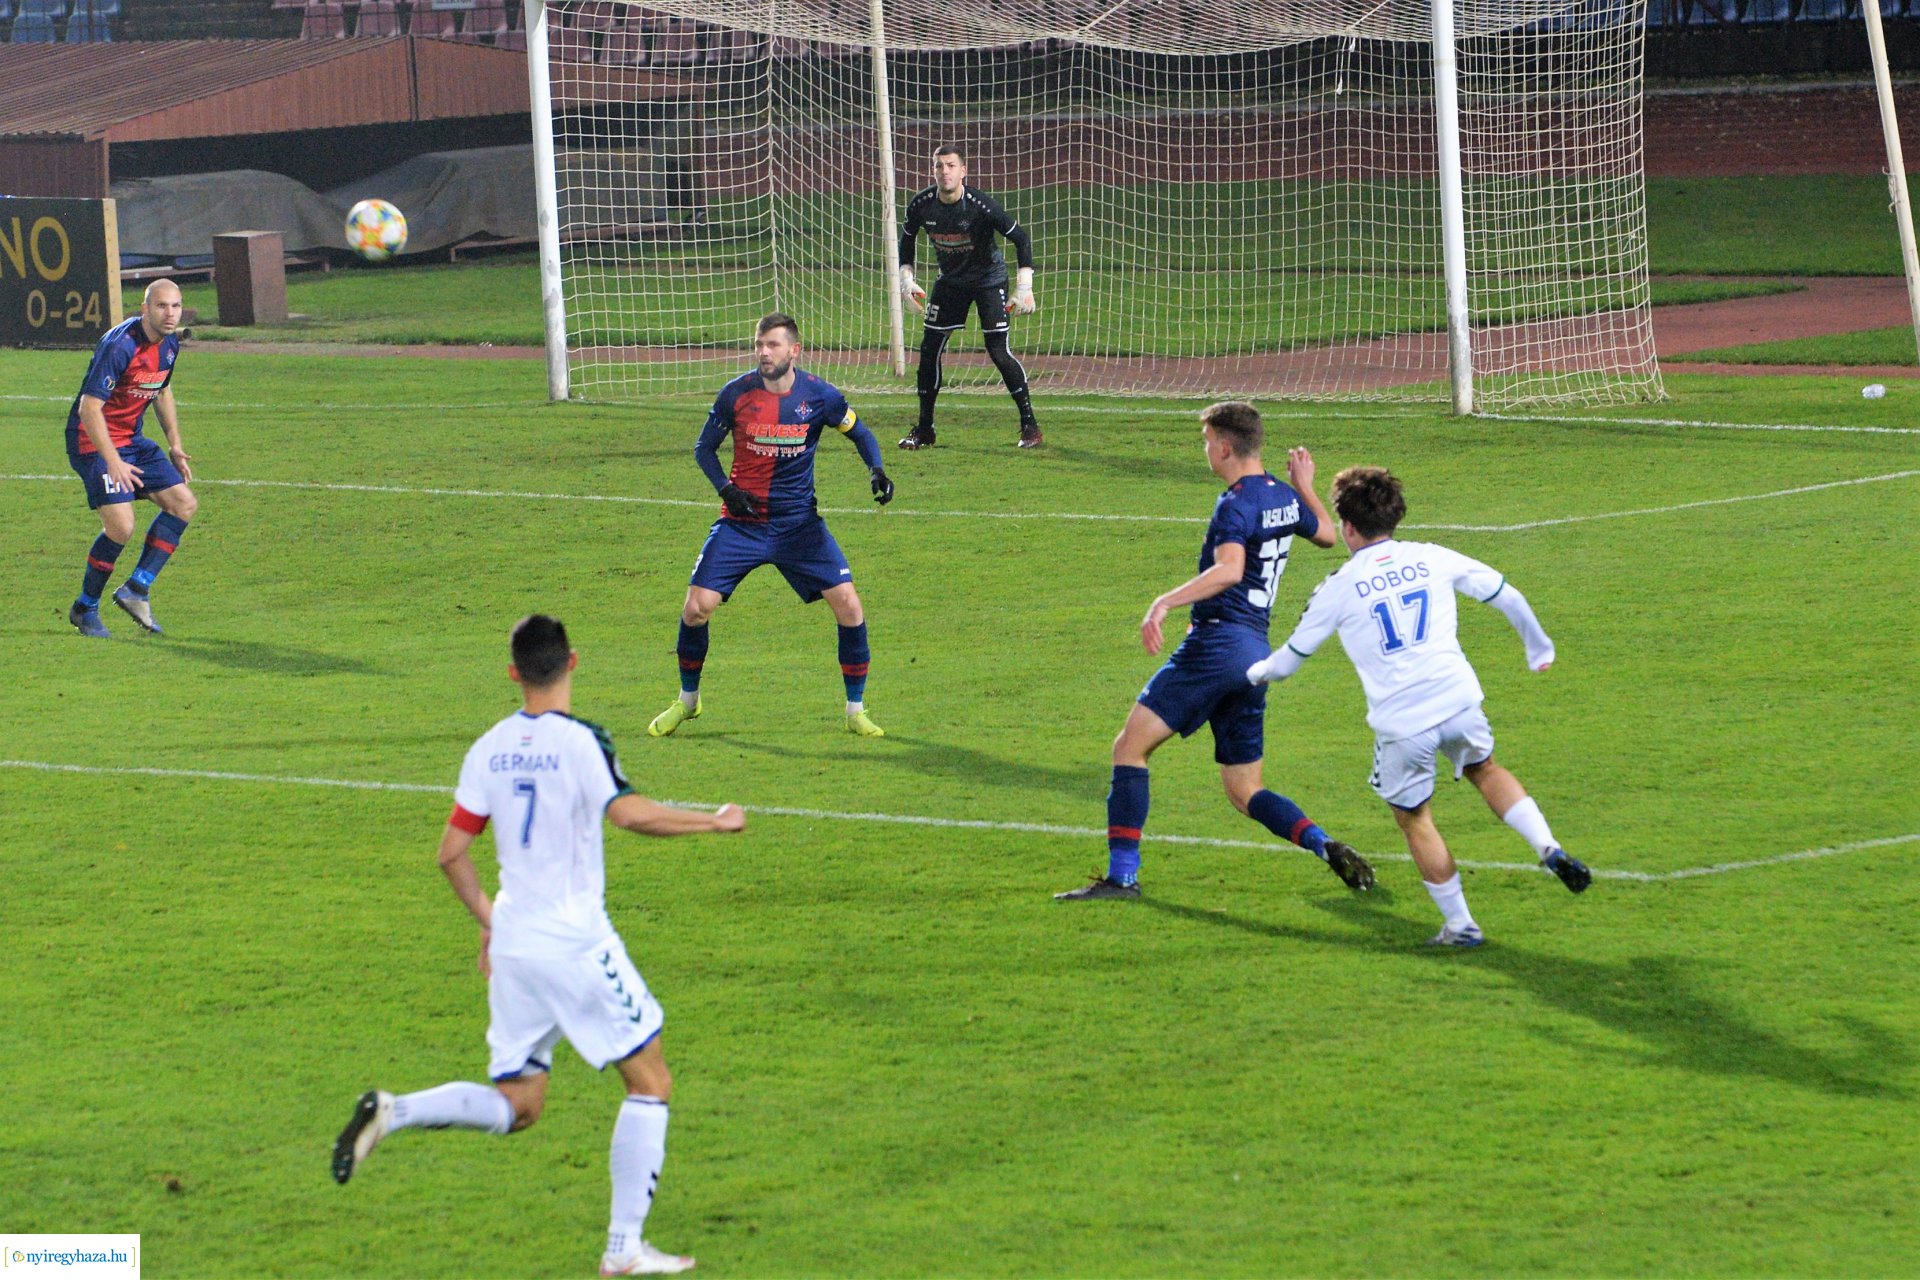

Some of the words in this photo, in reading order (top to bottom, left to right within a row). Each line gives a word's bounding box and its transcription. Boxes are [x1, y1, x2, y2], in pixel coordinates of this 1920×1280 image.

[27, 289, 102, 329] 0-24
[1355, 562, 1430, 598] DOBOS
[1369, 584, 1433, 656] 17
[489, 753, 559, 772] GERMAN
[513, 778, 536, 849] 7
